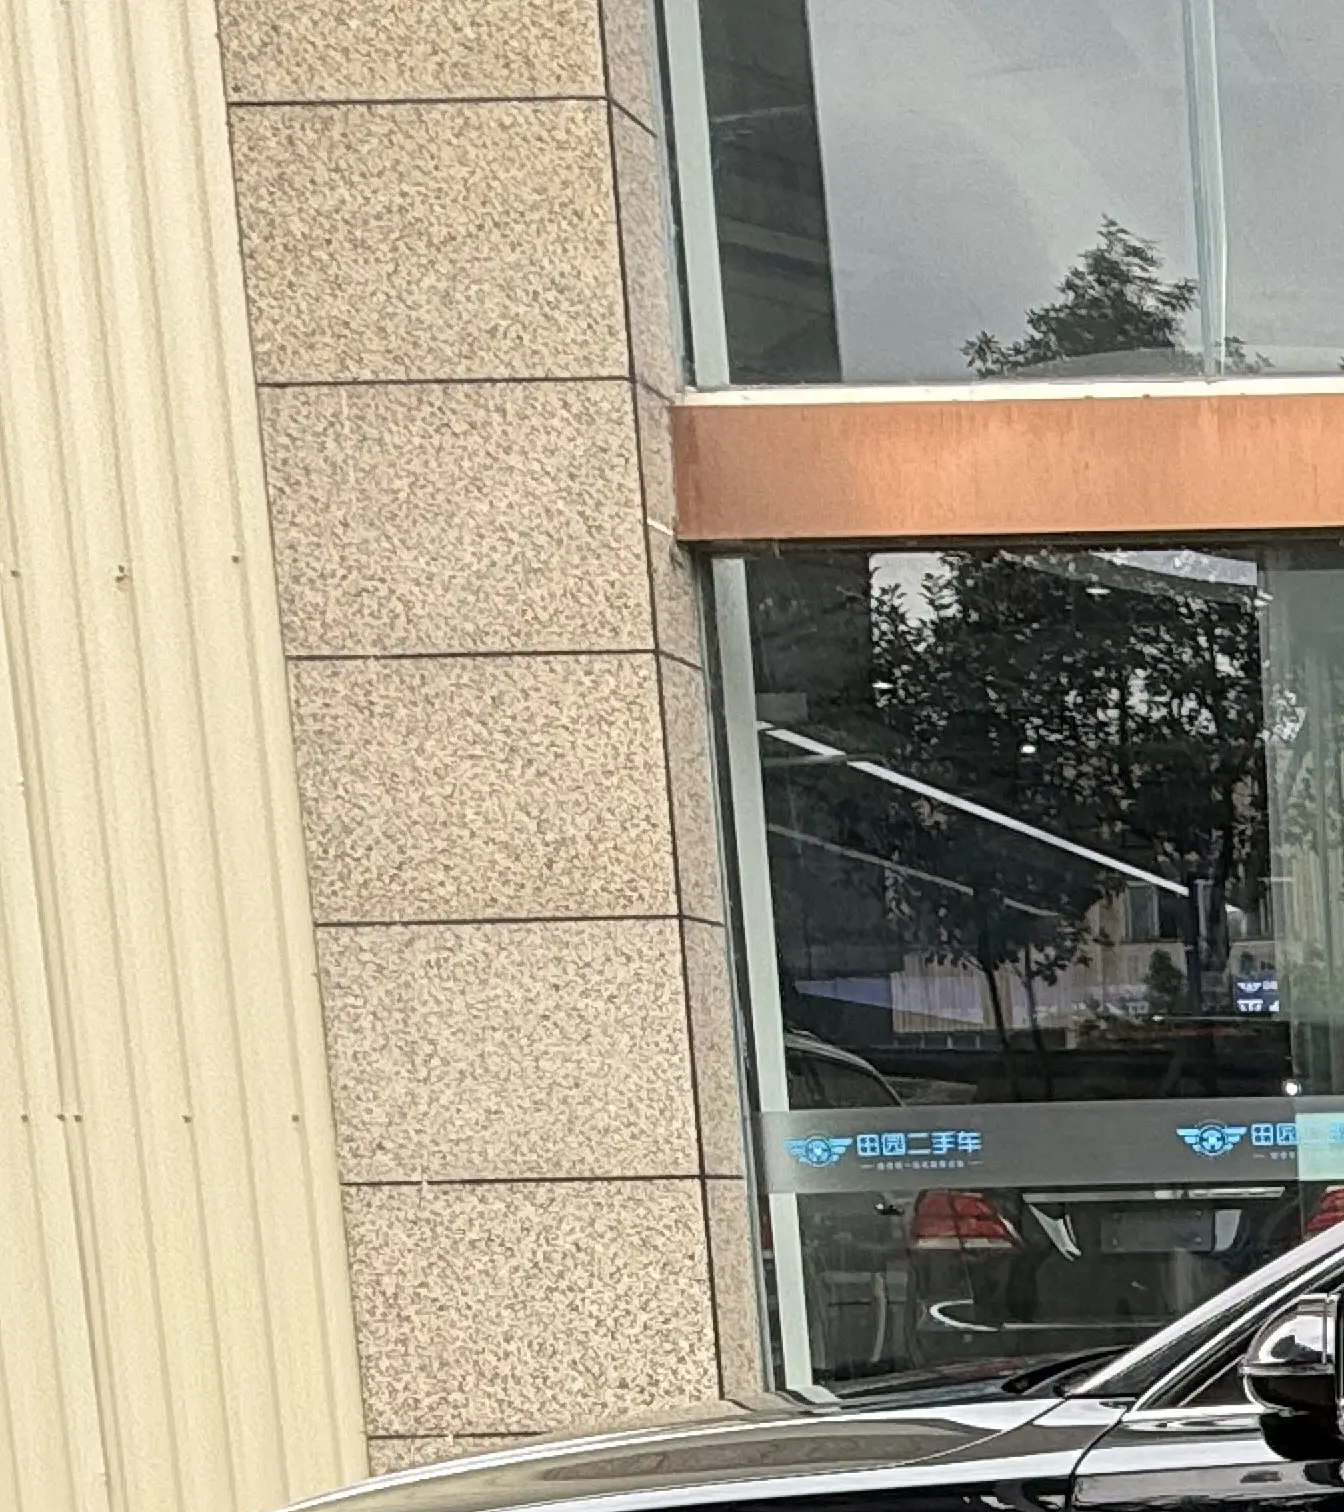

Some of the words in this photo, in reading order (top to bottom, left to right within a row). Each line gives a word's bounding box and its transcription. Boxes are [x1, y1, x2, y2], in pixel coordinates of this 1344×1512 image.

[856, 1130, 983, 1156] 田园二手车
